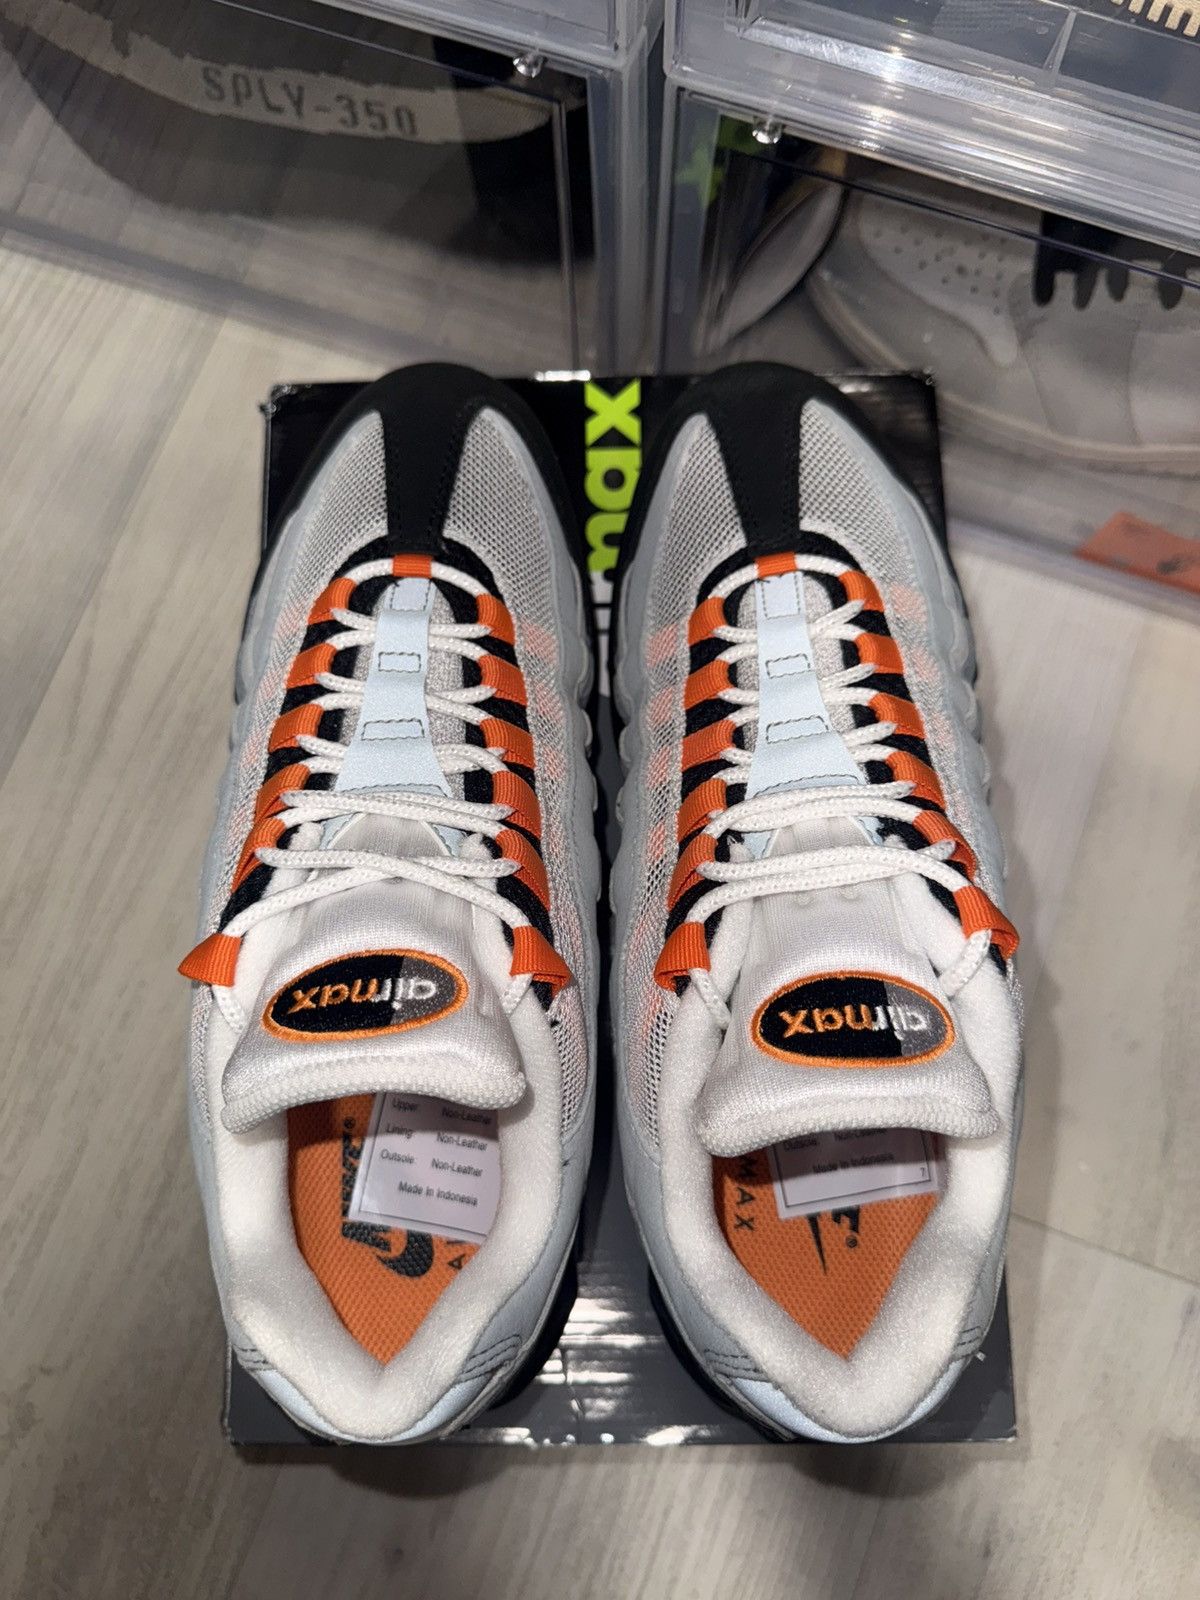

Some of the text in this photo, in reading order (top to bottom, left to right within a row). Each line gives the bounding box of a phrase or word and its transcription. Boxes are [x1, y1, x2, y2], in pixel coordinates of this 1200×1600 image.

[287, 978, 437, 1014] airmax
[778, 1004, 927, 1040] airmax
[437, 1132, 487, 1151] Non-Leather
[381, 1149, 483, 1177] Outsole Non-Leather
[398, 1181, 478, 1207] Made in Indonesia
